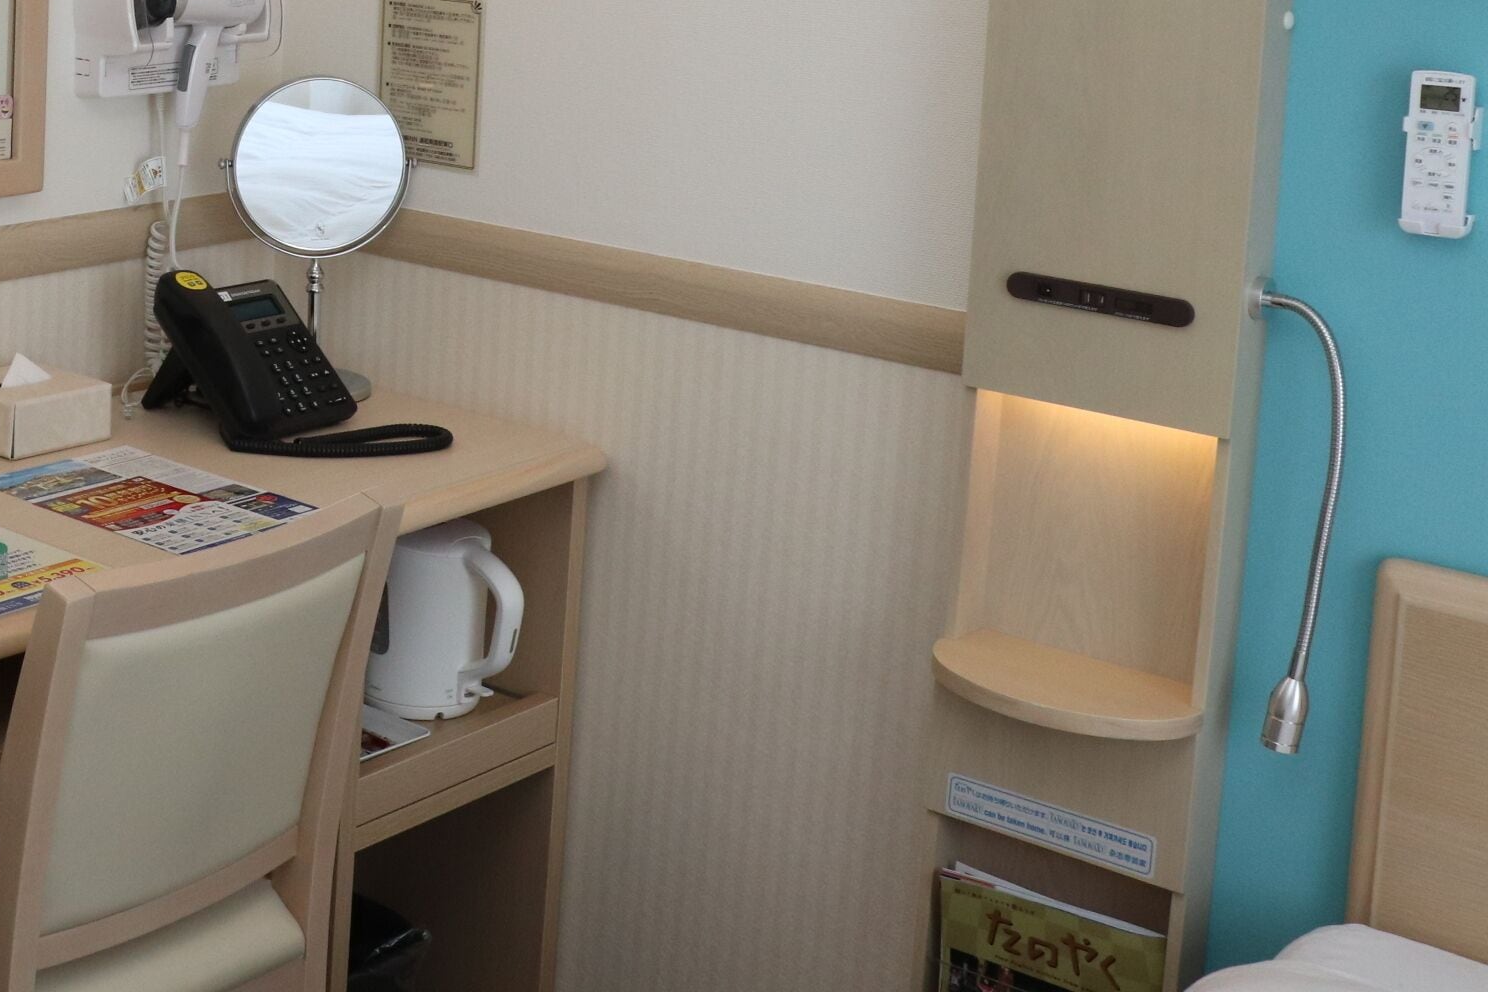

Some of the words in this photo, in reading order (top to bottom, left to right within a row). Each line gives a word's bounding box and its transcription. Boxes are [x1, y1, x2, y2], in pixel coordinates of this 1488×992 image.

[983, 808, 996, 819] can
[997, 812, 1006, 822] be
[1006, 816, 1026, 829] taken
[985, 908, 1121, 992] たのやく
